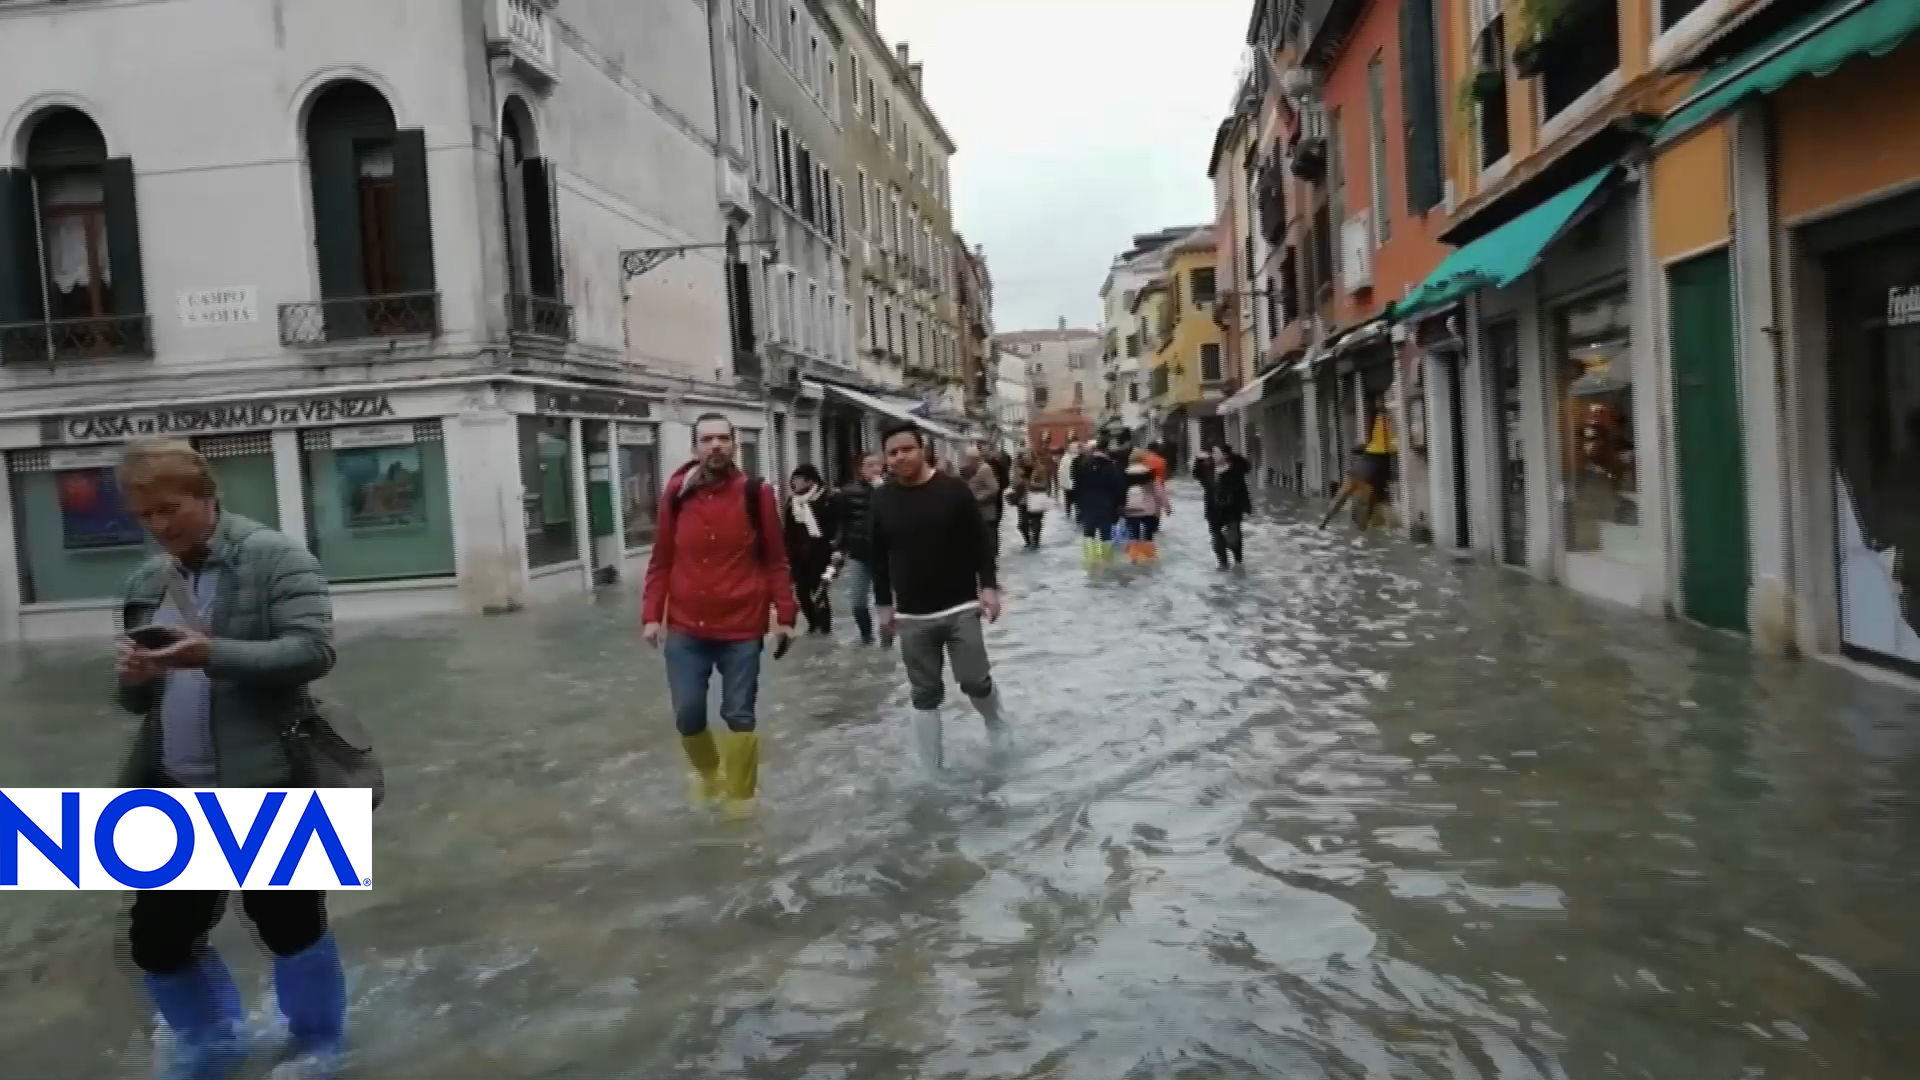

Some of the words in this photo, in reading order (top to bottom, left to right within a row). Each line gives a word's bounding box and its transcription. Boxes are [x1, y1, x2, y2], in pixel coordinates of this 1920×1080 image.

[69, 415, 134, 439] CASSA
[157, 404, 276, 434] RISPARMIO
[296, 396, 395, 422] VENEZIA
